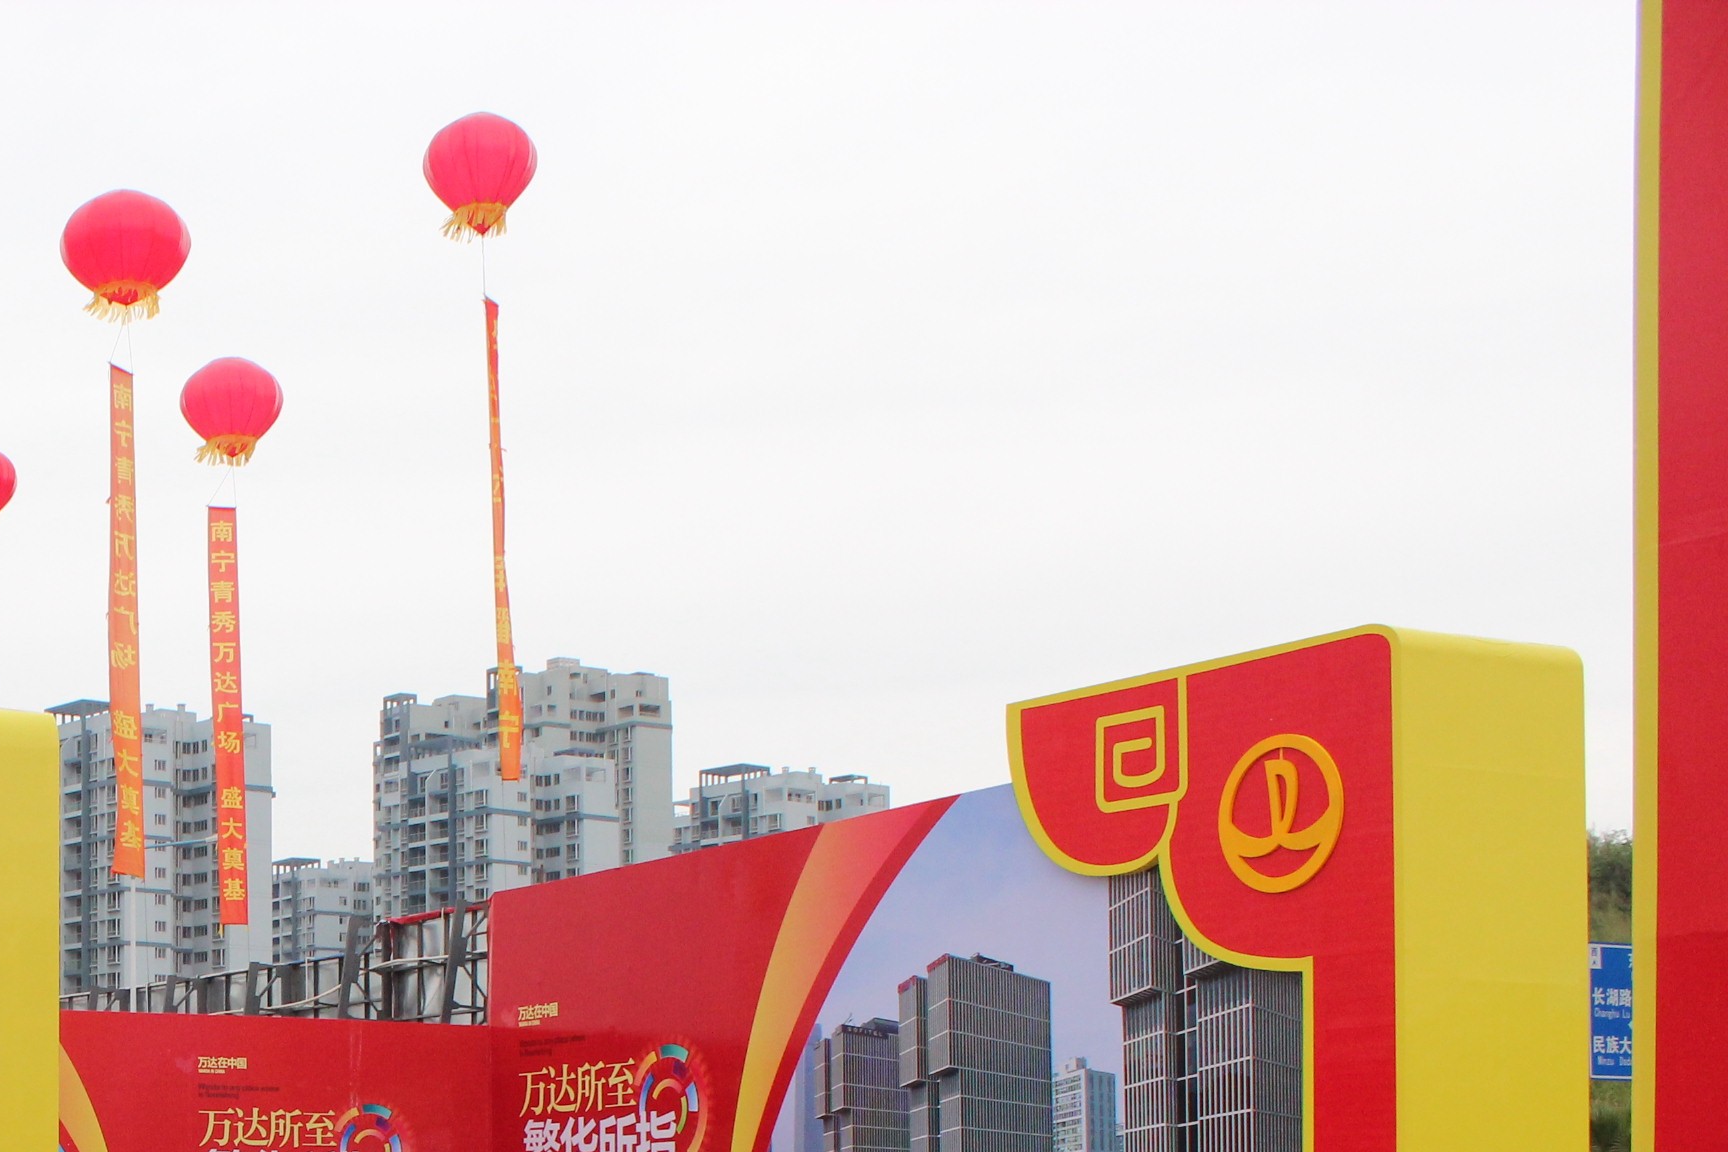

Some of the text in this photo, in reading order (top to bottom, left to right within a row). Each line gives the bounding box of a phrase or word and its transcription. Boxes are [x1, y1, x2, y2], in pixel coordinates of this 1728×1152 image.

[210, 520, 246, 902] 南宁青秀万达广场 盛大奠基
[1592, 987, 1632, 1007] 长湖路
[517, 1001, 559, 1021] 万达在中国
[1592, 1035, 1632, 1055] 民族大
[197, 1056, 248, 1070] 万达在中国
[518, 1057, 638, 1118] 万达所至
[198, 1107, 338, 1148] 万达所至
